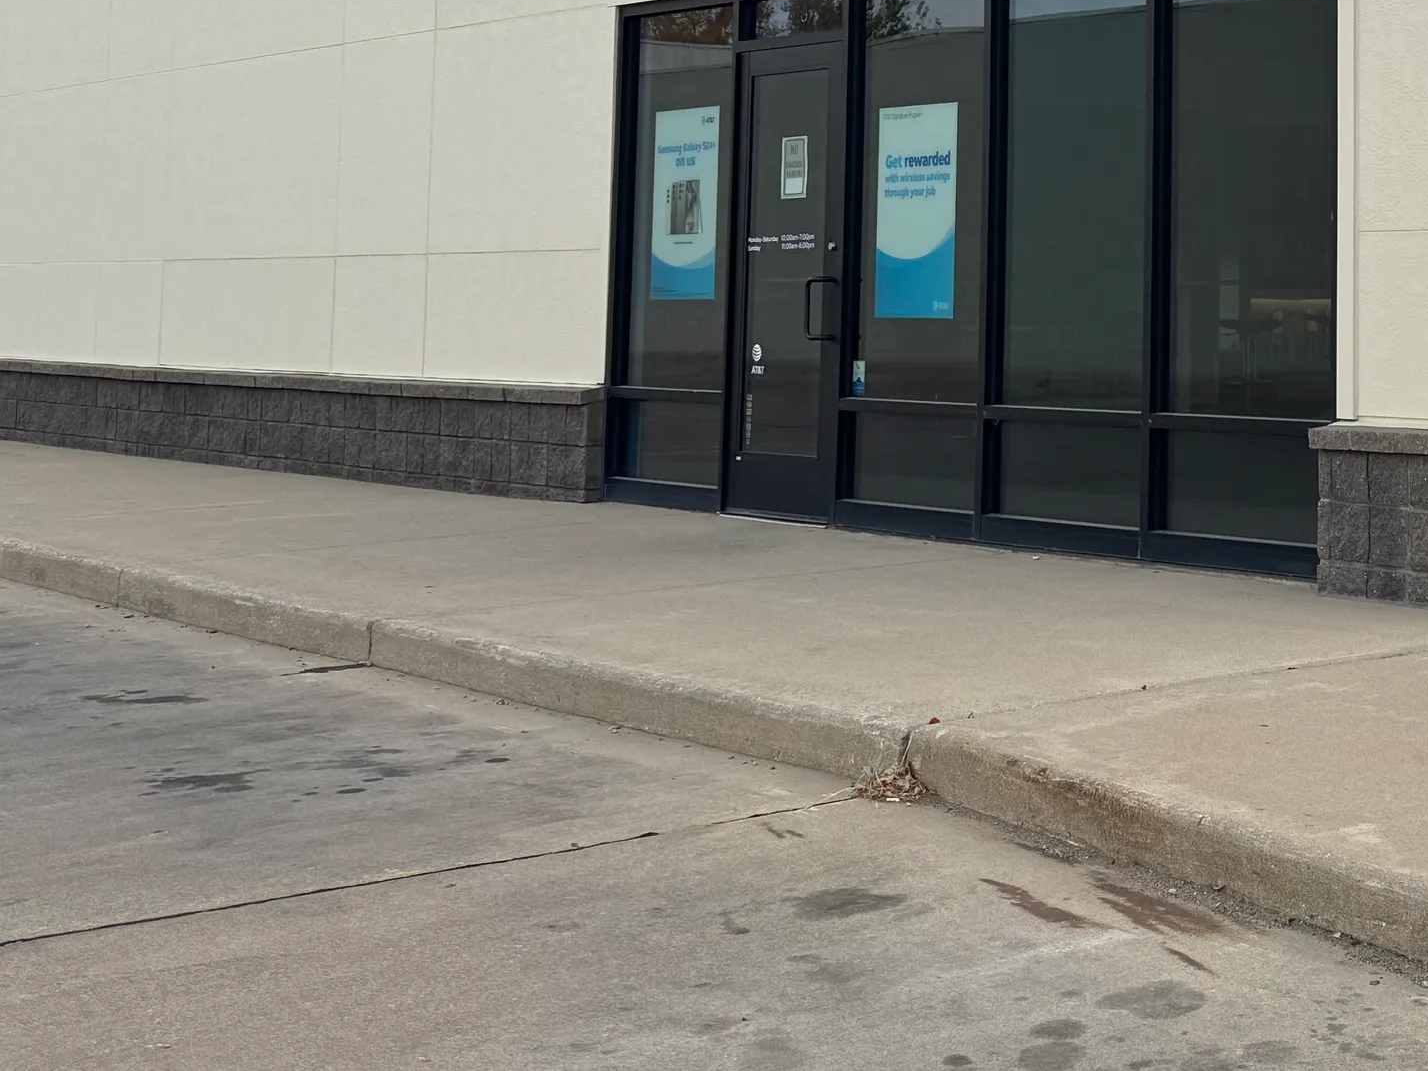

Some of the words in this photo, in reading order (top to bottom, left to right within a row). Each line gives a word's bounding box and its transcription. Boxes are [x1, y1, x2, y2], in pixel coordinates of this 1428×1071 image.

[676, 157, 685, 167] on
[885, 155, 902, 169] Get
[904, 150, 951, 168] rewarded
[885, 173, 900, 184] with
[900, 172, 925, 183] wireless
[926, 171, 951, 183] savings
[884, 186, 909, 200] through
[910, 187, 924, 199] your
[925, 186, 936, 199] job
[751, 365, 765, 374] AT&T
